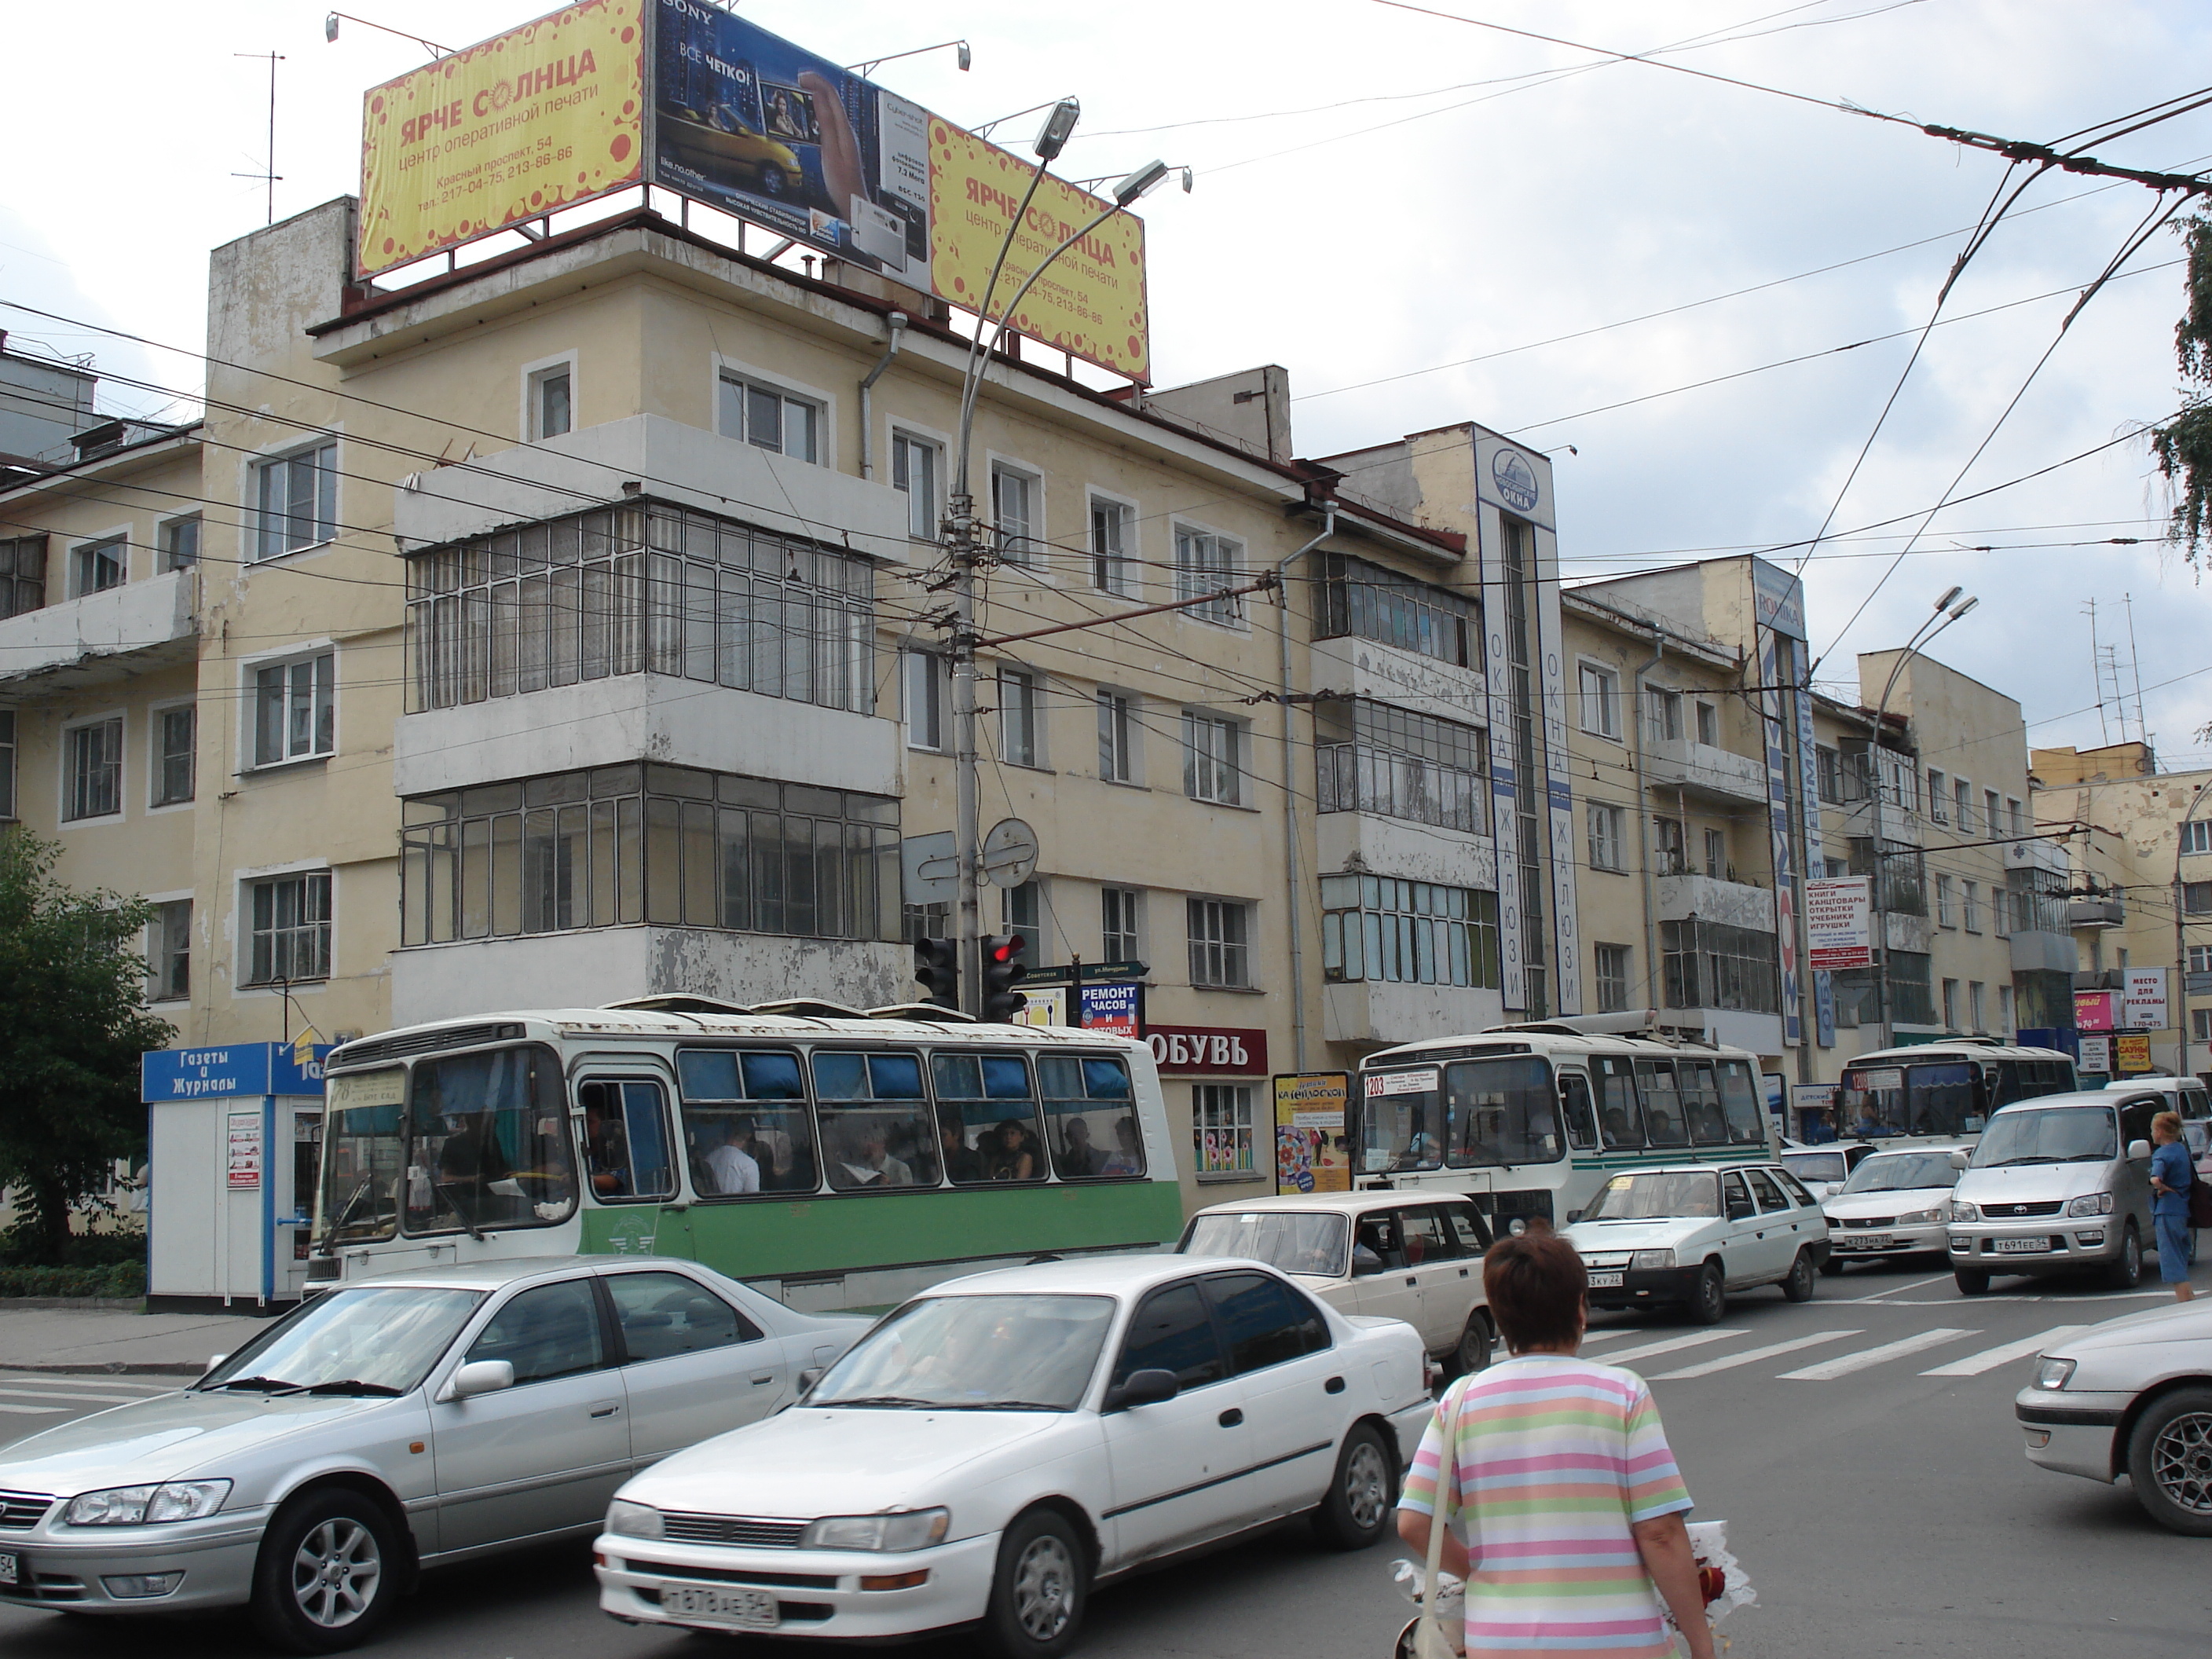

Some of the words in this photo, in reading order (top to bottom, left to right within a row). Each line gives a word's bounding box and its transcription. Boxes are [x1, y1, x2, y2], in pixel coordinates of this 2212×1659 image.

[679, 42, 701, 64] ВСЕ
[705, 54, 749, 86] ЧЕТКО!
[399, 145, 441, 171] центр
[445, 107, 539, 153] оперативной
[544, 84, 598, 115] печати
[401, 99, 463, 148] ЯРЧЕ
[437, 163, 482, 189] Красный
[484, 149, 535, 175] проспект,
[537, 136, 552, 151] 54
[441, 172, 505, 203] 217-04-75,
[507, 145, 573, 178] 213-86-86
[725, 196, 750, 211] ВЫСОКАЯ
[965, 177, 1018, 220] ЯРЧЕ
[966, 210, 1001, 237] центр
[1082, 264, 1118, 289] печати
[1077, 291, 1089, 304] 54
[1057, 297, 1103, 326] 213-86-86
[1503, 488, 1530, 510] ОКНА
[1759, 592, 1800, 627] ROMIKA
[1492, 634, 1507, 759] ОКНА
[1547, 654, 1562, 771] ОКНА
[1500, 808, 1518, 996] ЖАЛЮЗИ
[1556, 821, 1574, 1001] ЖАЛЮЗИ
[1809, 897, 1866, 906] КАНЦТОВАРЫ
[1810, 921, 1850, 930] ИГРУШКИ
[1082, 987, 1135, 1000] РЕМОНТ
[1091, 1000, 1126, 1010] ЧАСОВ
[1105, 1013, 1112, 1023] И
[180, 1051, 228, 1068] Газеты
[1145, 1034, 1248, 1065] ОБУВЬ
[200, 1066, 207, 1078] и
[173, 1077, 236, 1097] Журналы
[1366, 1076, 1384, 1097] 1203
[1998, 1240, 2034, 1250] Т691ЕЕ
[1588, 1276, 1608, 1286] 3КУ
